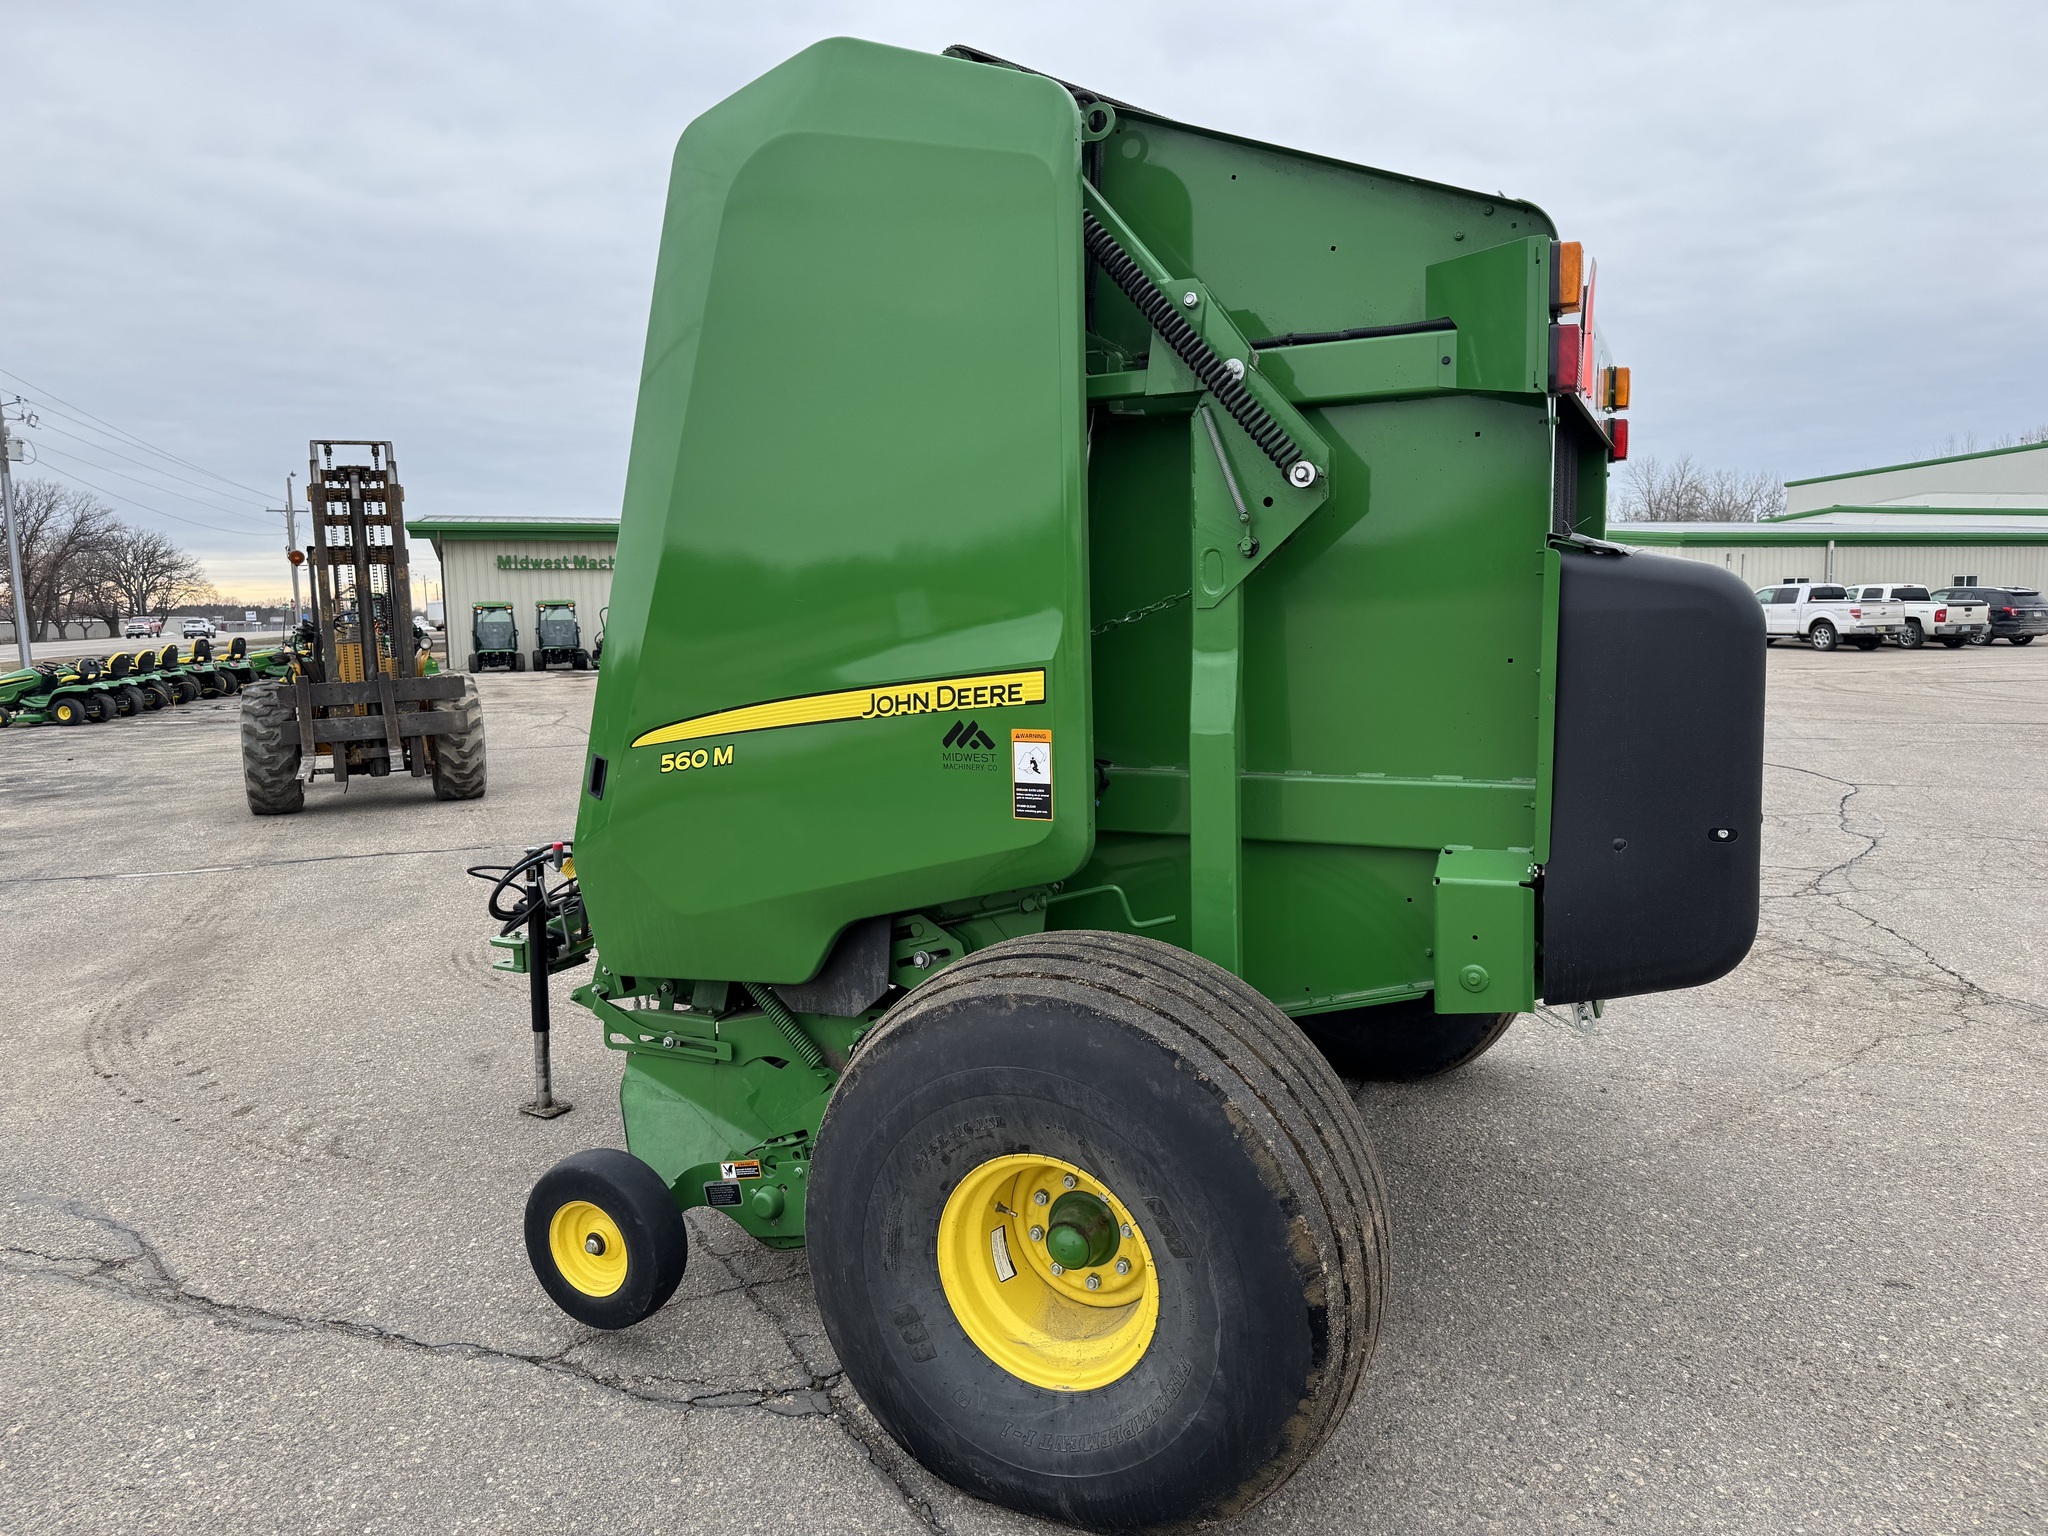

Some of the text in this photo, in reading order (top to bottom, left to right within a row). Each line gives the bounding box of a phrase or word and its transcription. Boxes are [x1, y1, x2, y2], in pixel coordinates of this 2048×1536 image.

[497, 555, 569, 570] Midwest
[862, 682, 1024, 717] JOHN DEERE
[660, 744, 735, 773] 560 M
[943, 753, 997, 763] MIDWEST
[943, 763, 985, 771] MACHINERY
[1156, 1355, 1193, 1416] FARM
[1038, 1403, 1158, 1453] IMPLEMENT
